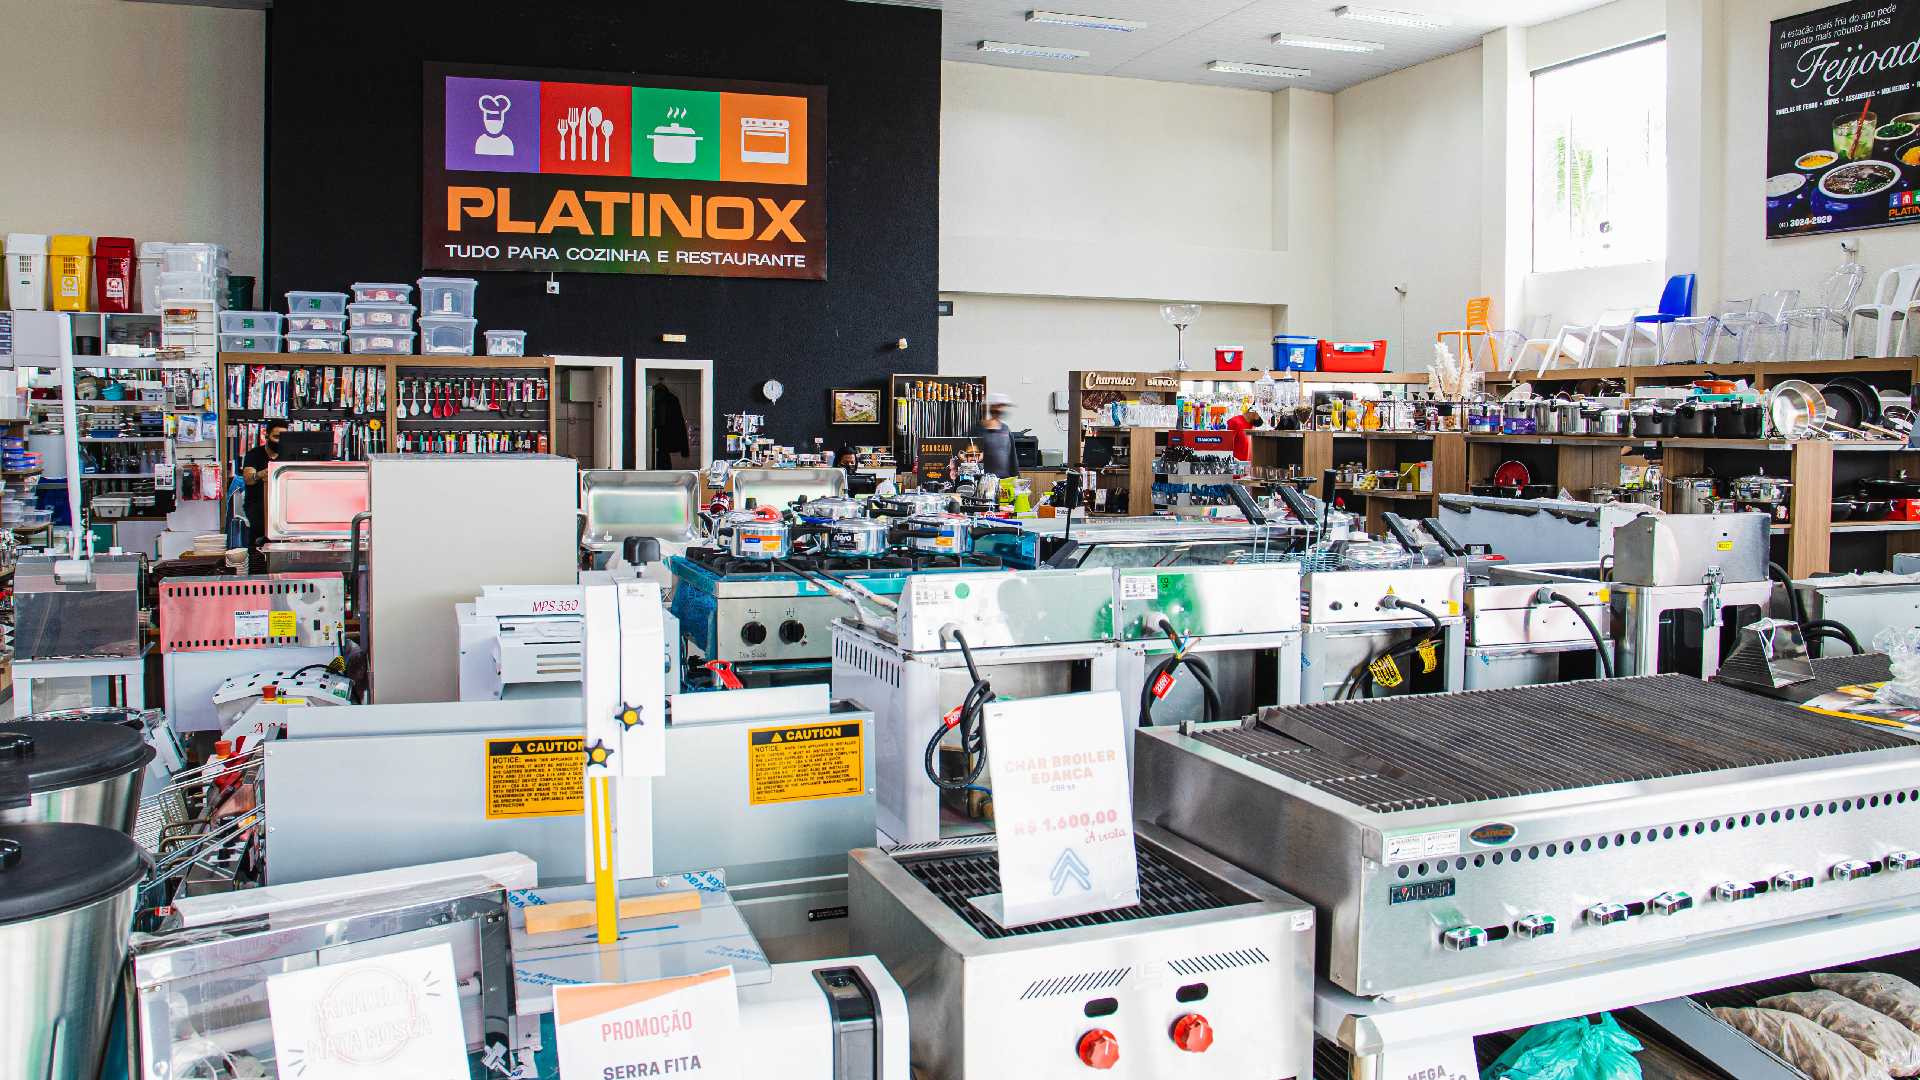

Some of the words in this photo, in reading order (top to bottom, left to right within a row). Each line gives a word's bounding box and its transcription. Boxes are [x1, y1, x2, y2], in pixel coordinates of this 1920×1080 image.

[1788, 26, 1813, 36] estação
[1816, 20, 1832, 31] mais
[1849, 14, 1859, 23] do
[1861, 10, 1875, 20] ano
[1877, 4, 1897, 18] pede
[1794, 36, 1813, 48] prato
[1815, 30, 1832, 41] mais
[1834, 24, 1862, 37] robusto
[1871, 17, 1890, 28] mesa
[1824, 98, 1839, 106] COPOS
[1845, 91, 1875, 102] ASSADEIRAS
[1881, 83, 1910, 95] MOLHEIRAS
[447, 185, 807, 243] PLATINOX
[445, 244, 500, 259] TUDO
[507, 245, 559, 260] PARA
[566, 246, 650, 263] COZINHA
[657, 250, 669, 262] E
[676, 250, 806, 268] RESTAURANTE
[1085, 372, 1136, 390] Churrasco
[532, 600, 555, 613] MPS
[557, 599, 579, 612] 350
[786, 727, 841, 740] CAUTION
[1004, 757, 1048, 773] CHAR
[1051, 749, 1117, 768] BROILER
[1031, 766, 1094, 785] EDANCA
[1014, 819, 1038, 836] R$
[1042, 808, 1118, 832] 1.600,00
[1474, 829, 1513, 839] PLATINOX
[1401, 882, 1452, 901] VULCAN
[310, 979, 421, 1024] ARMADILHA
[601, 1009, 693, 1042] PROMOÇÃO
[305, 1028, 363, 1063] MATA
[364, 1013, 434, 1049] MOSCA
[603, 1061, 661, 1080] SERRA
[664, 1055, 702, 1074] FITA
